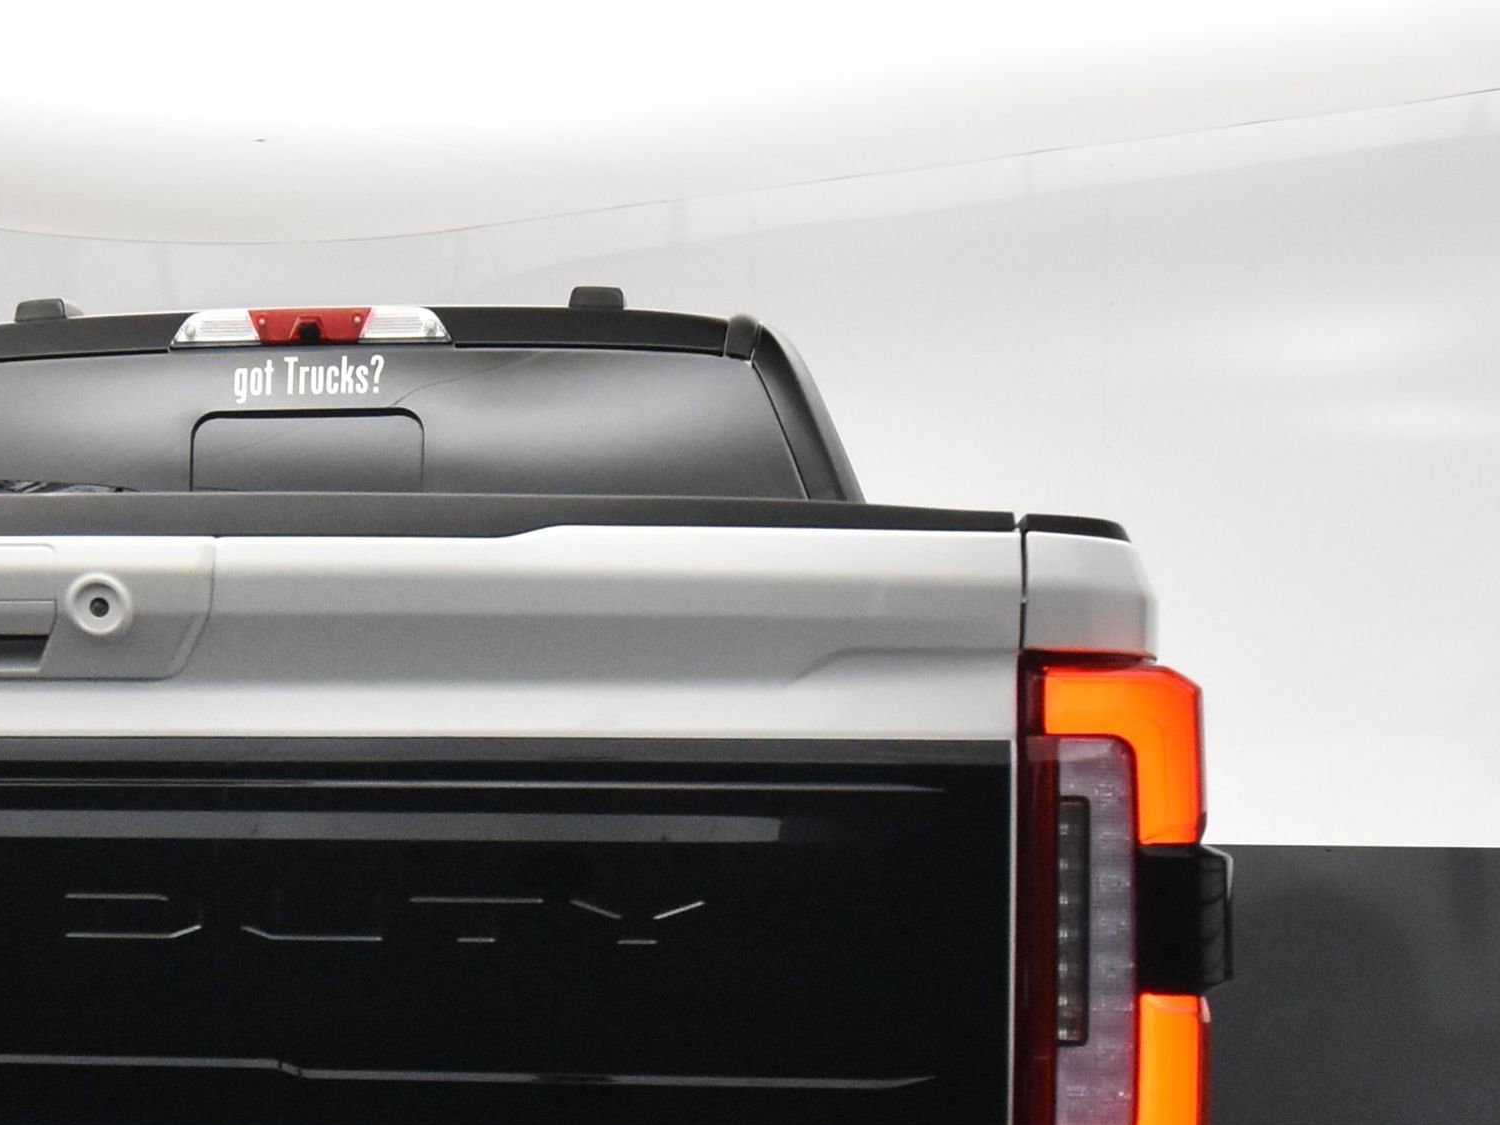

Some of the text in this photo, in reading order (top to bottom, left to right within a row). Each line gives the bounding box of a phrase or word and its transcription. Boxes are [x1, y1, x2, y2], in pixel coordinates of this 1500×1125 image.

[234, 354, 385, 403] got Trucks?
[65, 893, 706, 946] DUTY
